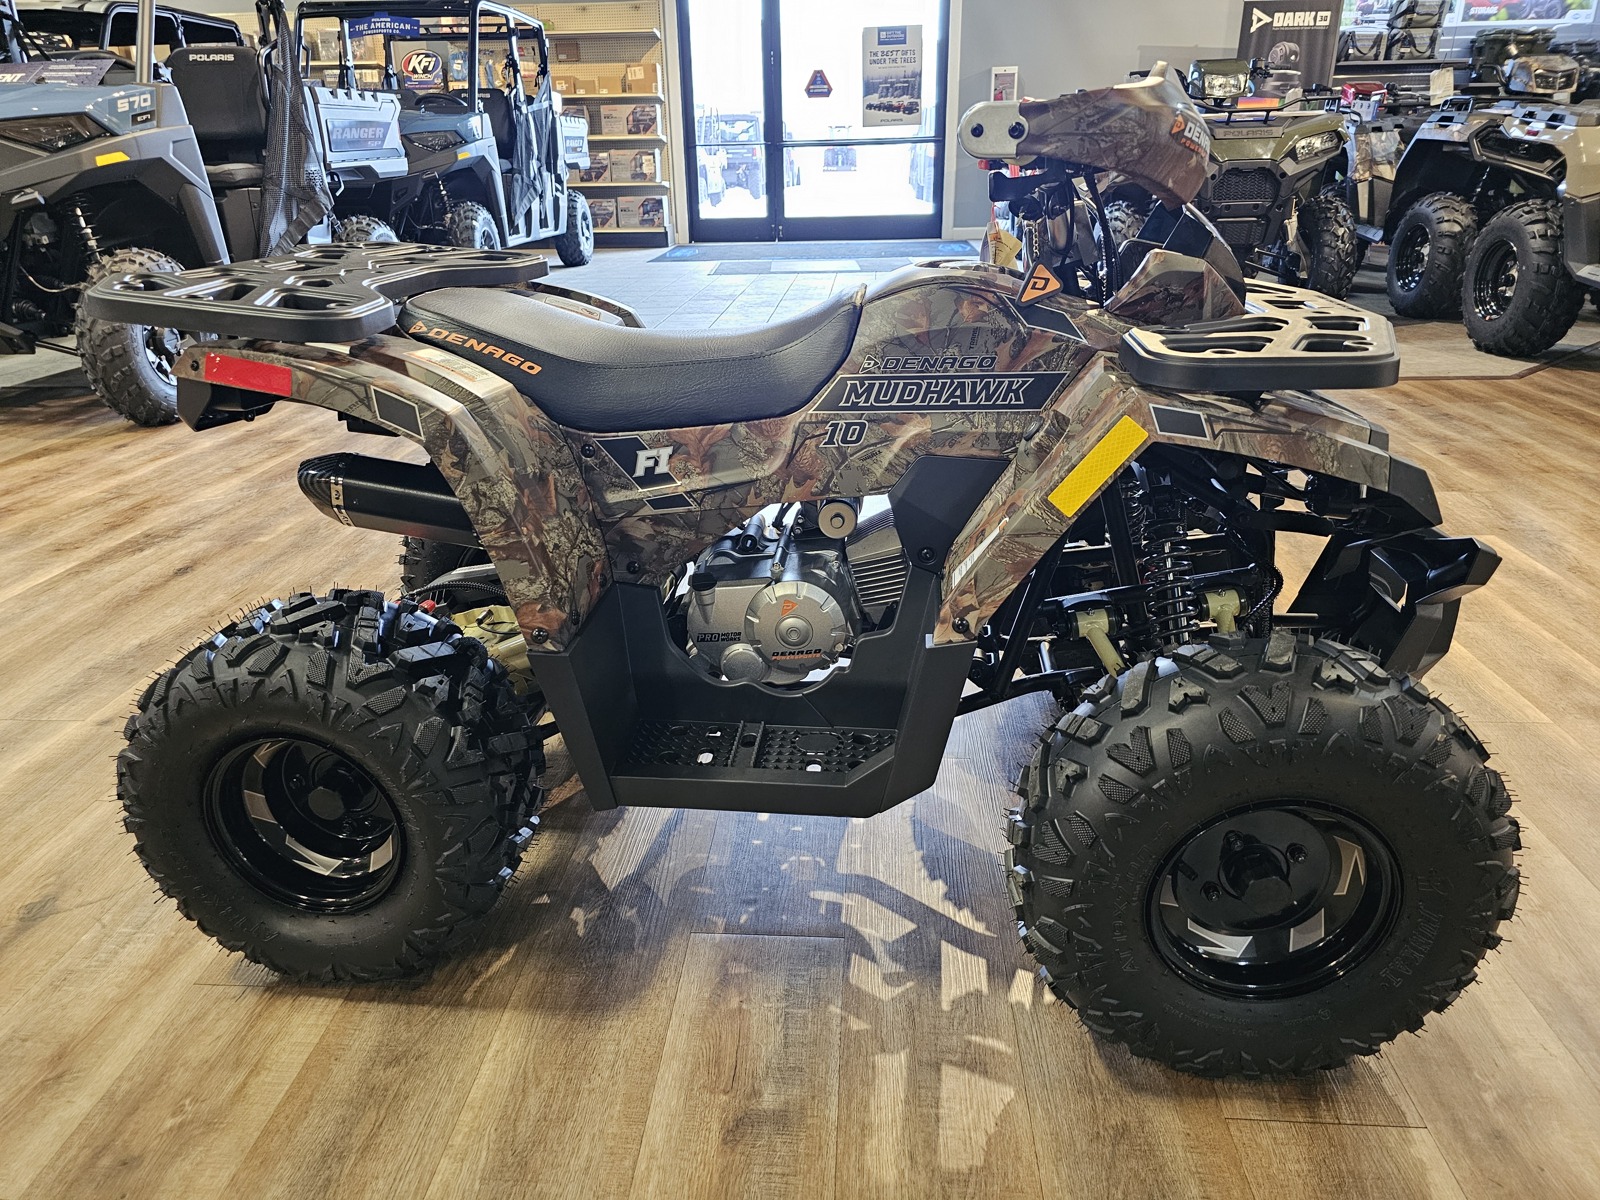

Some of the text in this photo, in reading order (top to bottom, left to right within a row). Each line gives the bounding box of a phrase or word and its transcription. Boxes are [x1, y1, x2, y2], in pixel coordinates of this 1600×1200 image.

[1273, 11, 1316, 27] DARK
[355, 21, 411, 31] THE AMERICAN
[189, 53, 235, 61] POLARIS
[869, 50, 879, 58] THE
[880, 49, 900, 57] BEST
[900, 56, 917, 64] TREES
[116, 94, 151, 112] 570
[332, 126, 385, 139] RANGER
[427, 328, 543, 376] DENAGO
[880, 355, 998, 370] DENAGO
[838, 377, 1035, 407] MUDHAWK
[819, 419, 869, 448] 10
[632, 446, 674, 478] FI
[698, 633, 720, 642] PRO
[771, 649, 822, 657] DENAGO
[771, 653, 821, 661] POWERSPORTS
